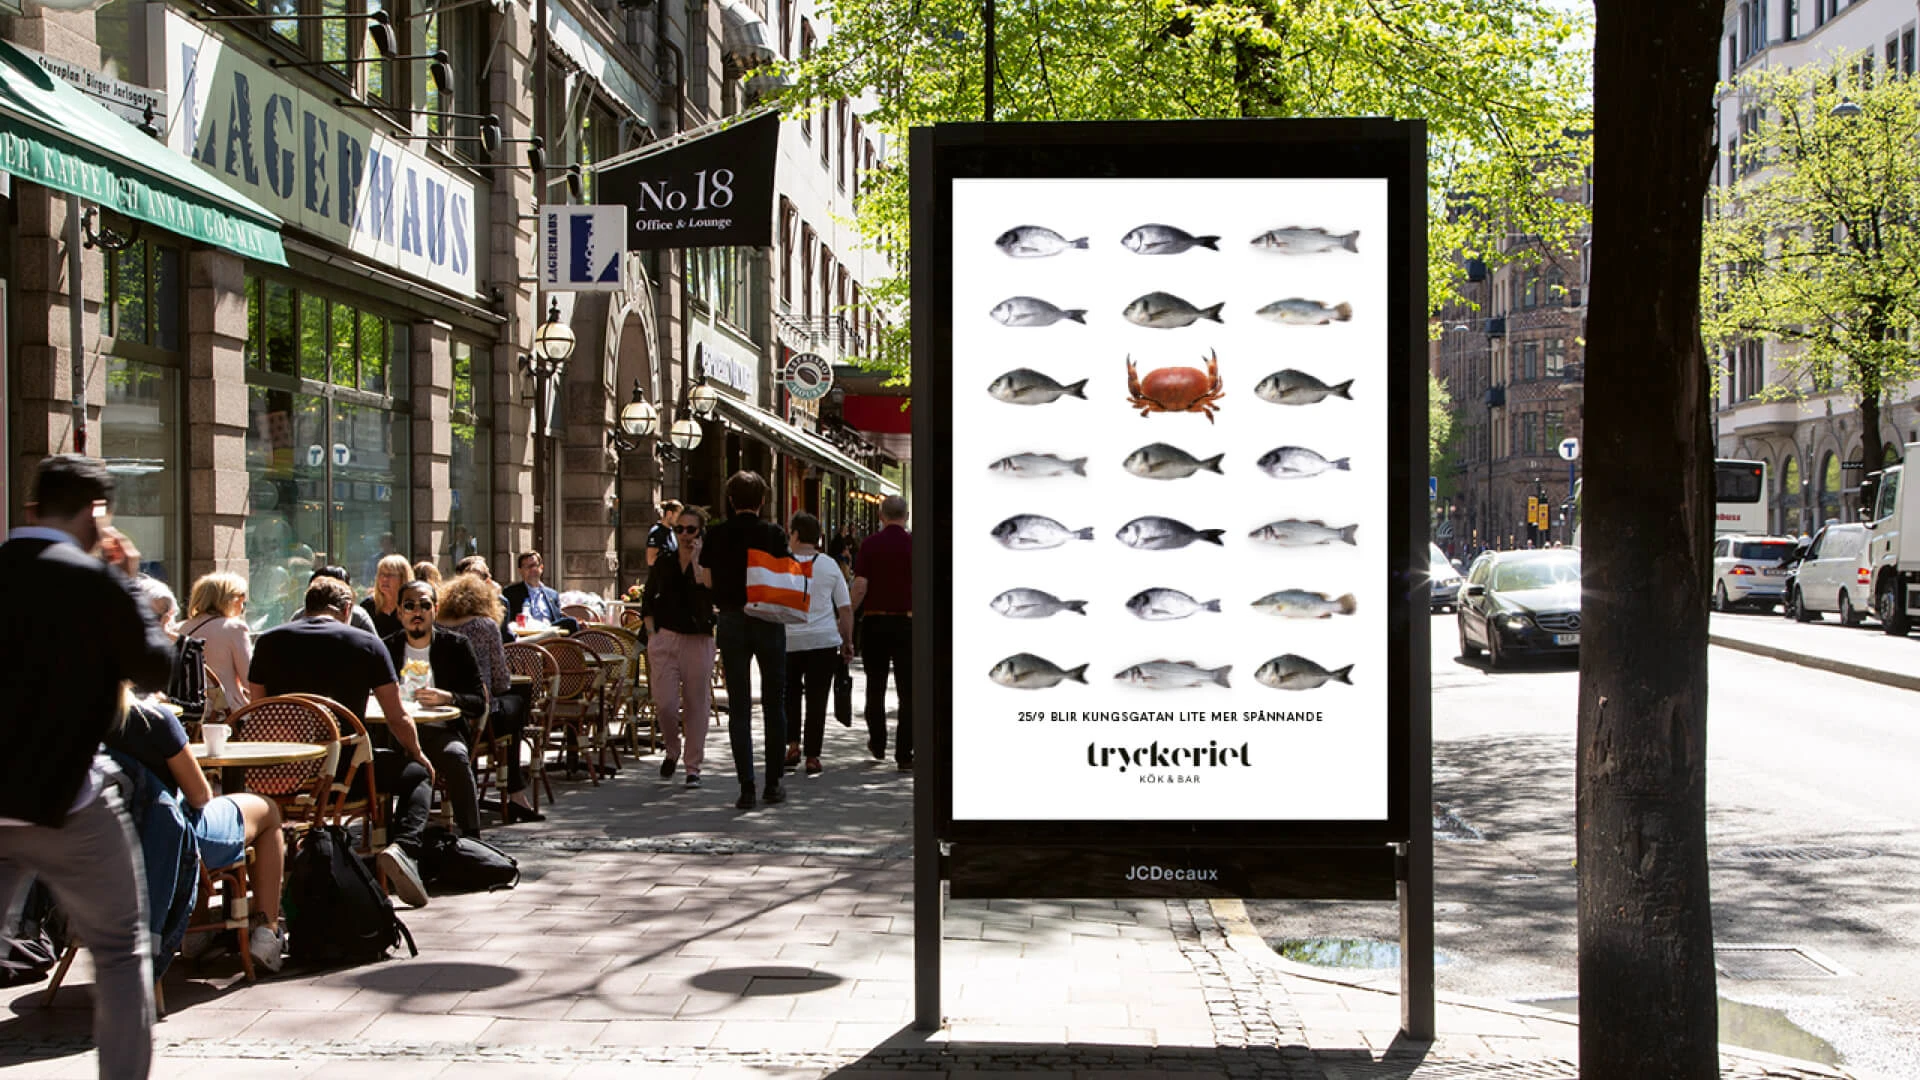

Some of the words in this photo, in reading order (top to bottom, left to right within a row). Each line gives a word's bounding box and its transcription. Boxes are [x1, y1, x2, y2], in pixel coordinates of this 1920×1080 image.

[86, 73, 111, 95] Birger
[181, 42, 469, 276] LAGERHAUS
[0, 132, 38, 178] ER,
[43, 148, 102, 196] KAFFE
[147, 190, 195, 231] ANNAN
[637, 181, 687, 212] No
[692, 168, 735, 211] 18
[635, 219, 673, 231] Office
[676, 219, 685, 229] &
[688, 217, 732, 229] Lounge
[548, 213, 558, 283] LAGERHAUS
[788, 354, 829, 374] ESPRESSO
[1562, 443, 1576, 457] T
[1017, 711, 1045, 722] 25/9
[1050, 711, 1077, 722] BLIR
[1082, 711, 1174, 722] KUNGSGATAN
[1179, 711, 1206, 722] LITE
[1211, 711, 1238, 722] MER
[1087, 740, 1252, 773] tryckeriet
[1166, 774, 1174, 784] &
[1177, 774, 1201, 784] BAR
[1125, 865, 1219, 881] JCDecaux
